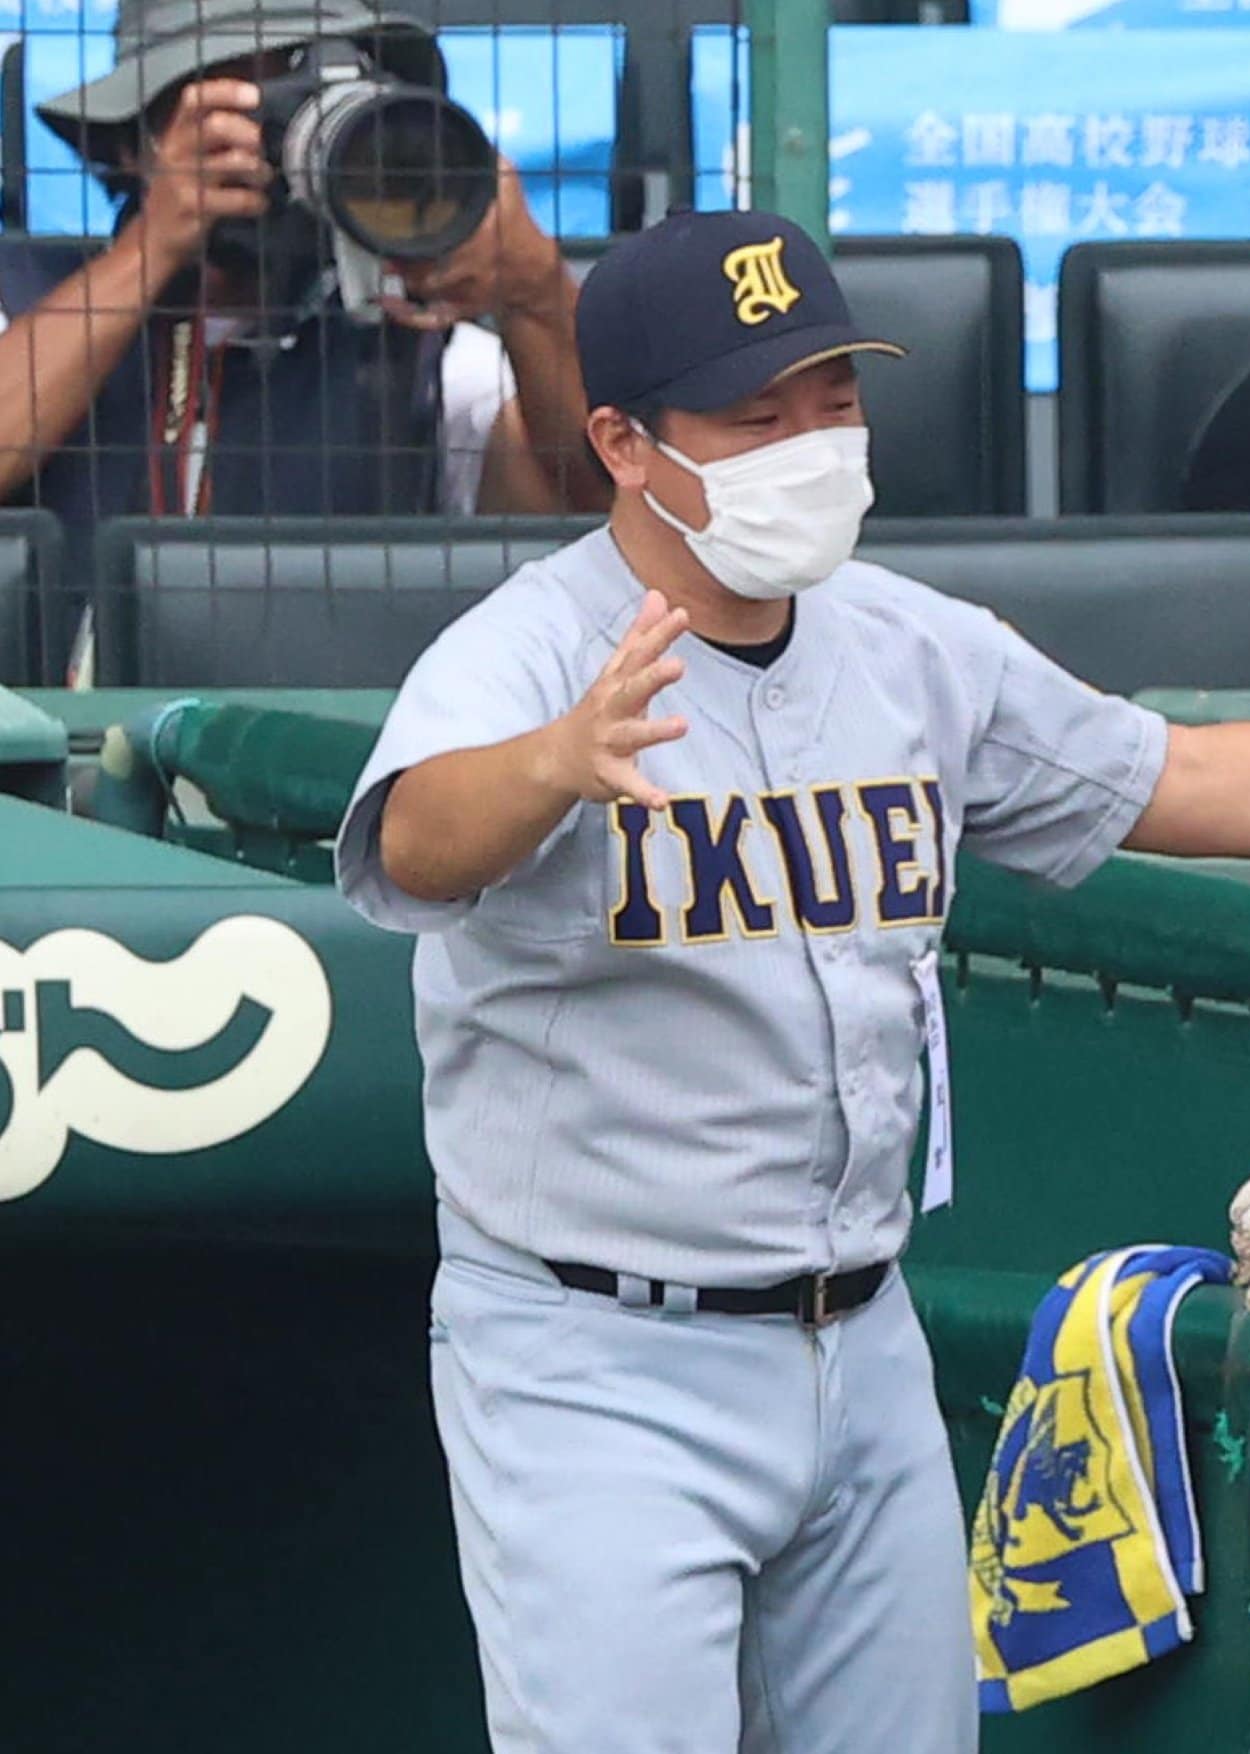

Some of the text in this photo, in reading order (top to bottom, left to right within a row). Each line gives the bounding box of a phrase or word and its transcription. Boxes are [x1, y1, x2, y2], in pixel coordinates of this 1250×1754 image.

[902, 180, 1188, 236] 選手権大会
